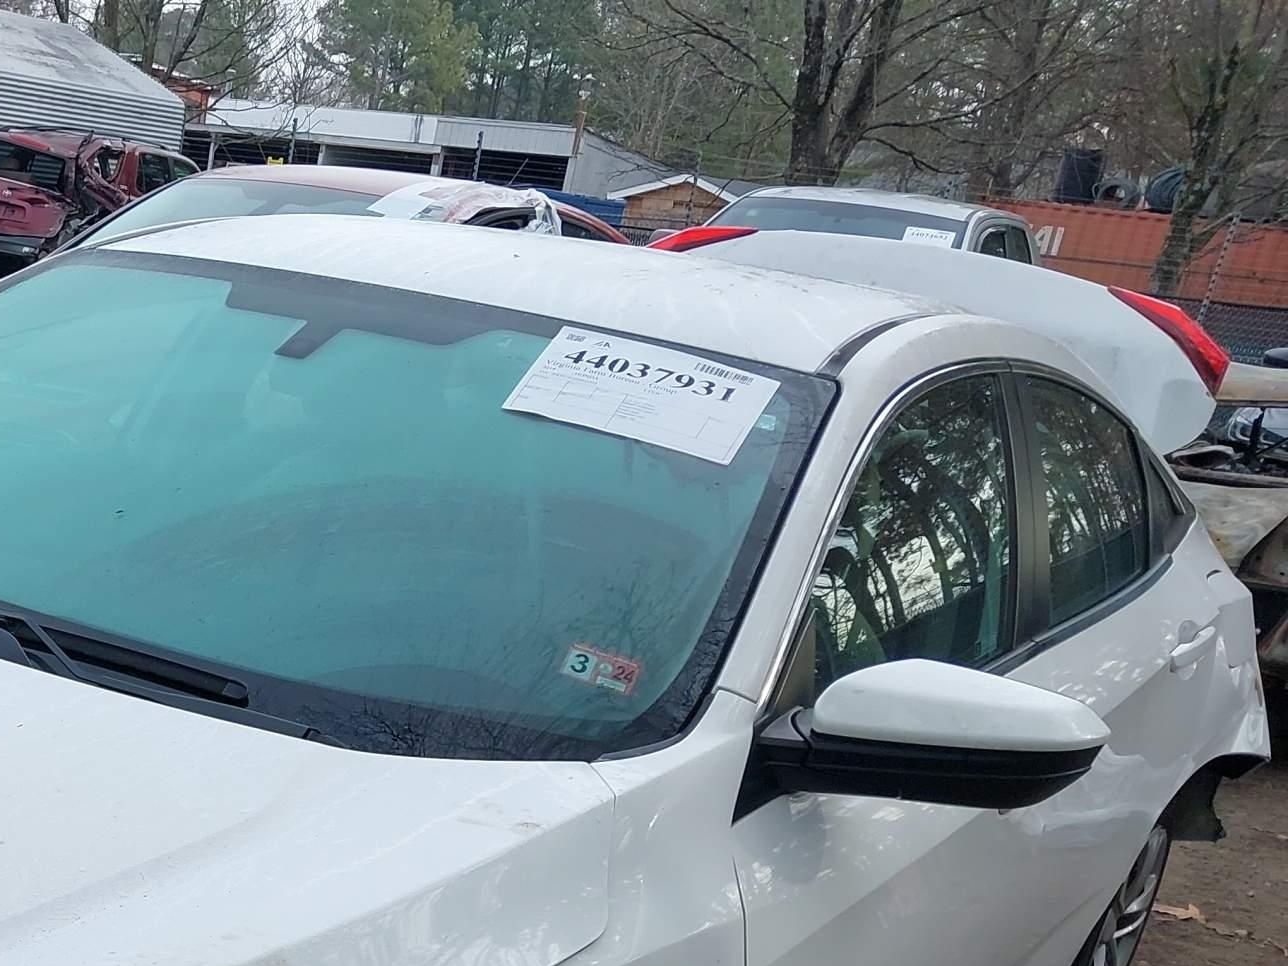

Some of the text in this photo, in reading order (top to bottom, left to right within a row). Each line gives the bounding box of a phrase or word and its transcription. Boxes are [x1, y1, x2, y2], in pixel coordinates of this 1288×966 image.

[547, 360, 581, 372] Virginia
[564, 350, 737, 402] 44037931
[570, 653, 589, 673] 3
